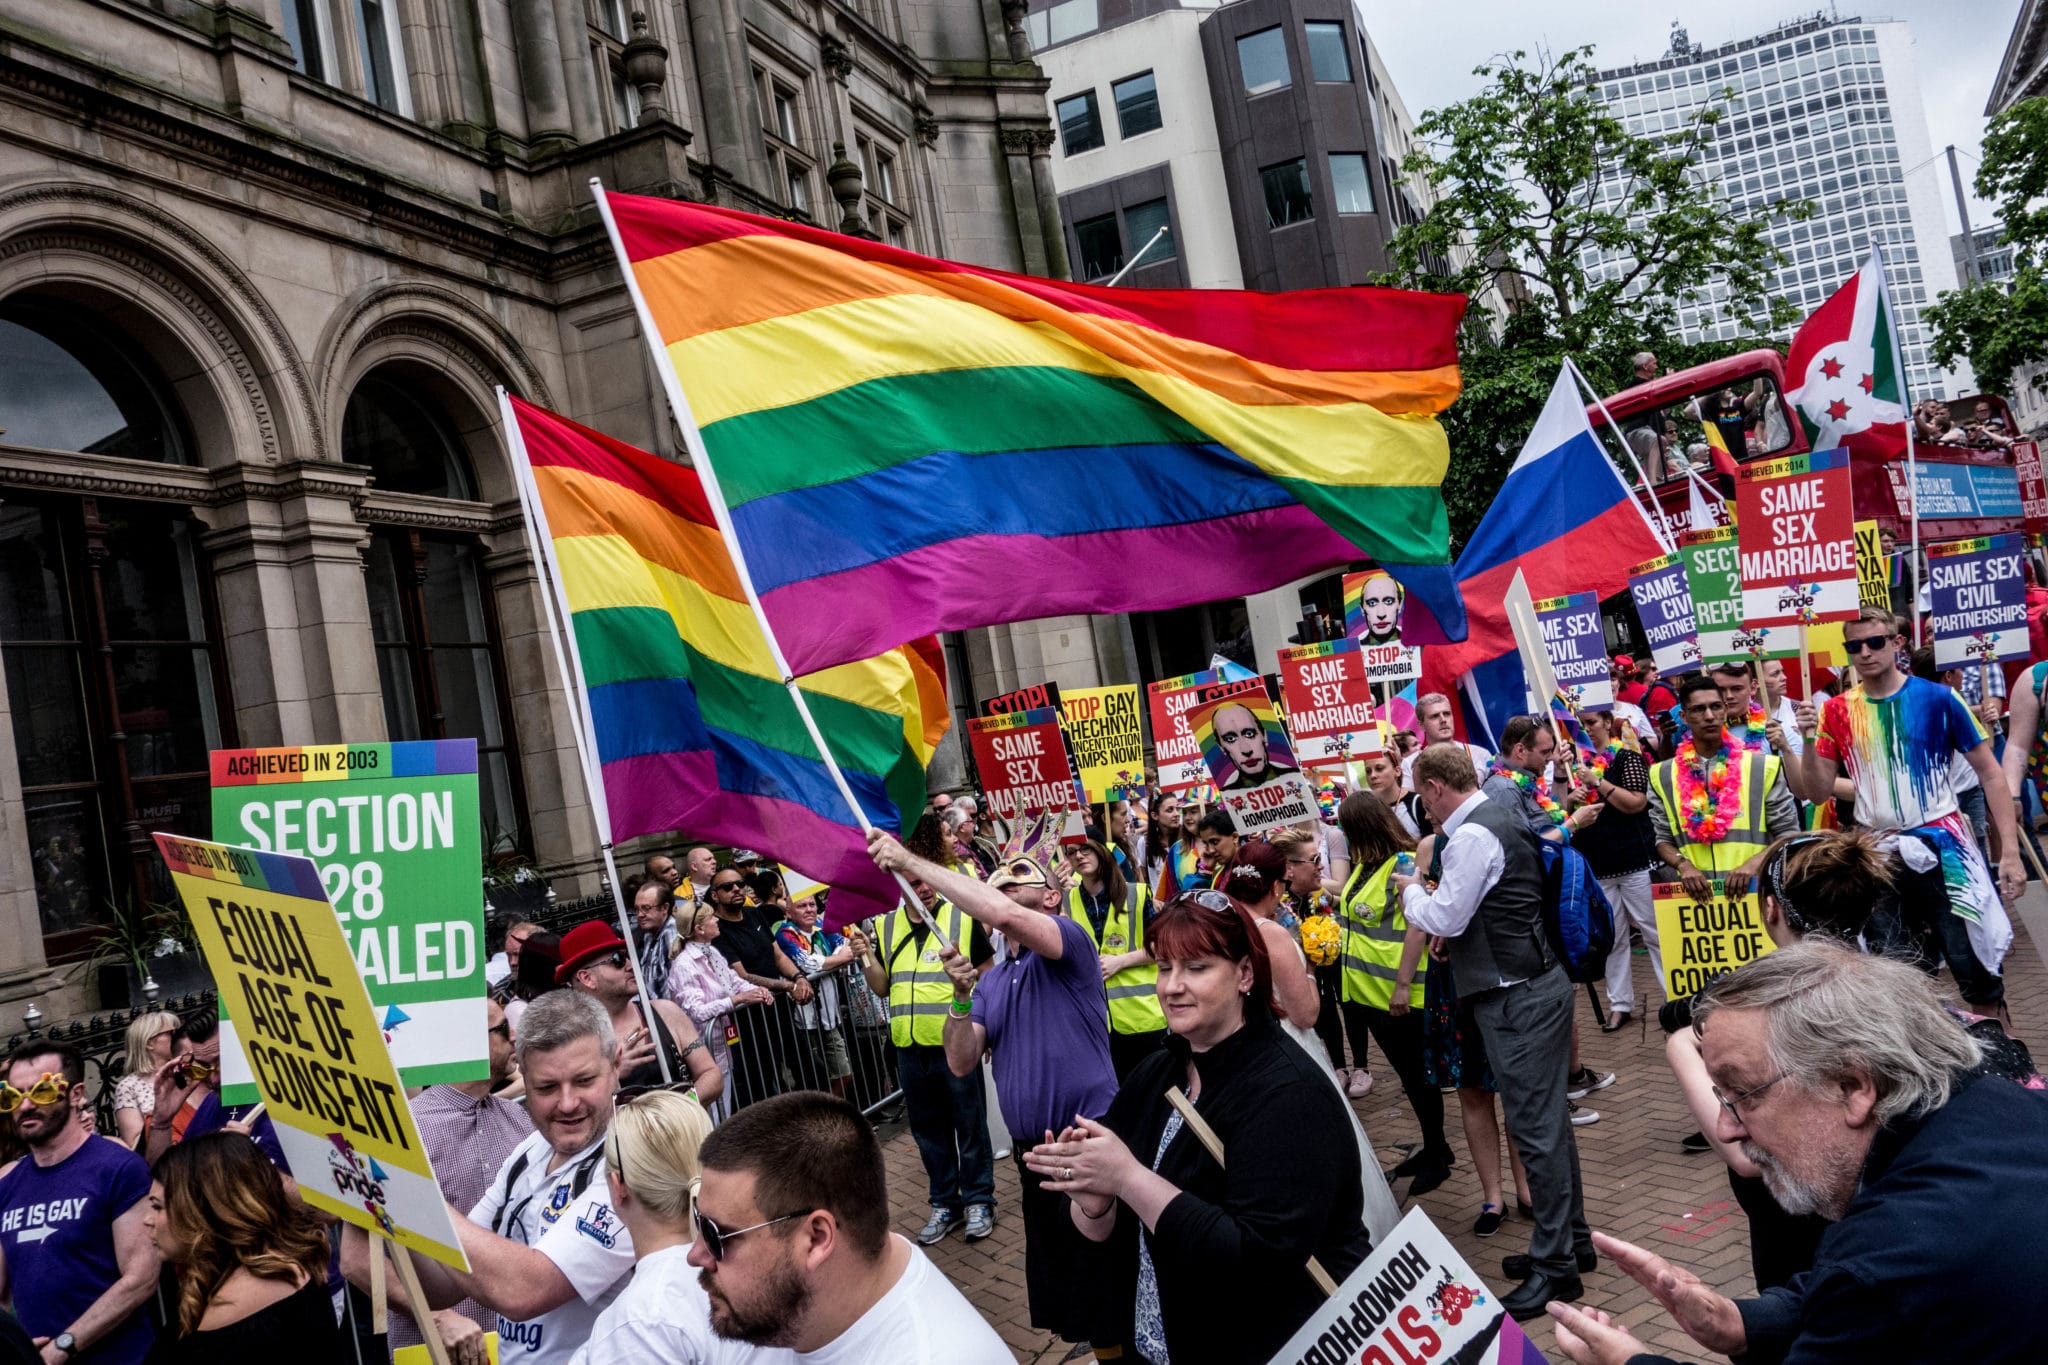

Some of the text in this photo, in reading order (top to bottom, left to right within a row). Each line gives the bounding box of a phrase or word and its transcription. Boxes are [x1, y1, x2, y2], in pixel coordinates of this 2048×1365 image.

[1741, 460, 1804, 479] ACHIEVED IN 2014
[1760, 478, 1825, 516] SAME
[1686, 530, 1716, 541] ACHIEVED
[1717, 529, 1724, 537] IN
[1726, 527, 1738, 537] 200
[1772, 512, 1818, 546] SEX
[1693, 546, 1741, 574] SECT
[1742, 540, 1856, 581] MARRIAGE
[1932, 555, 2021, 589] SAME SEX
[1634, 573, 1683, 605] SAME
[1726, 572, 1741, 596] 2
[1956, 583, 2001, 610] CIVIL
[1661, 593, 1694, 620] CIVI
[1696, 598, 1744, 625] REPE
[1779, 593, 1814, 612] pride
[1566, 612, 1599, 637] SEX
[1934, 603, 2027, 633] PARTNERSHIPS
[1368, 646, 1400, 665] STOP
[1732, 636, 1764, 651] pride
[1966, 641, 1994, 656] pride
[1300, 659, 1348, 686] SAME
[1104, 691, 1136, 717] GAY
[1312, 683, 1346, 708] SEX
[1069, 713, 1140, 742] HECHNYA
[1293, 702, 1375, 733] MARRIAGE
[992, 731, 1046, 761] SAME
[1109, 745, 1143, 765] NOW!
[1325, 741, 1350, 754] pride
[227, 750, 379, 776] ACHIEVED IN 2003
[1006, 758, 1044, 785] SEX
[1182, 766, 1203, 779] pride
[986, 779, 1077, 813] MARRIAGE
[1246, 785, 1286, 811] STOP
[239, 791, 454, 857] SECTION
[1241, 801, 1309, 828] HOMOPHOBIA
[164, 839, 256, 877] ACHIEVED IN 2001
[325, 861, 384, 920] 28
[1678, 902, 1758, 933] EQUAL
[206, 896, 333, 988] EQUAL
[1682, 933, 1763, 965] AGE OF
[238, 972, 357, 1065] AGE OF
[248, 1040, 410, 1150] CONSENT
[332, 1168, 386, 1205] pride
[1, 1197, 89, 1233] HE IS GAY
[1296, 1241, 1432, 1365] HOMOPHOB
